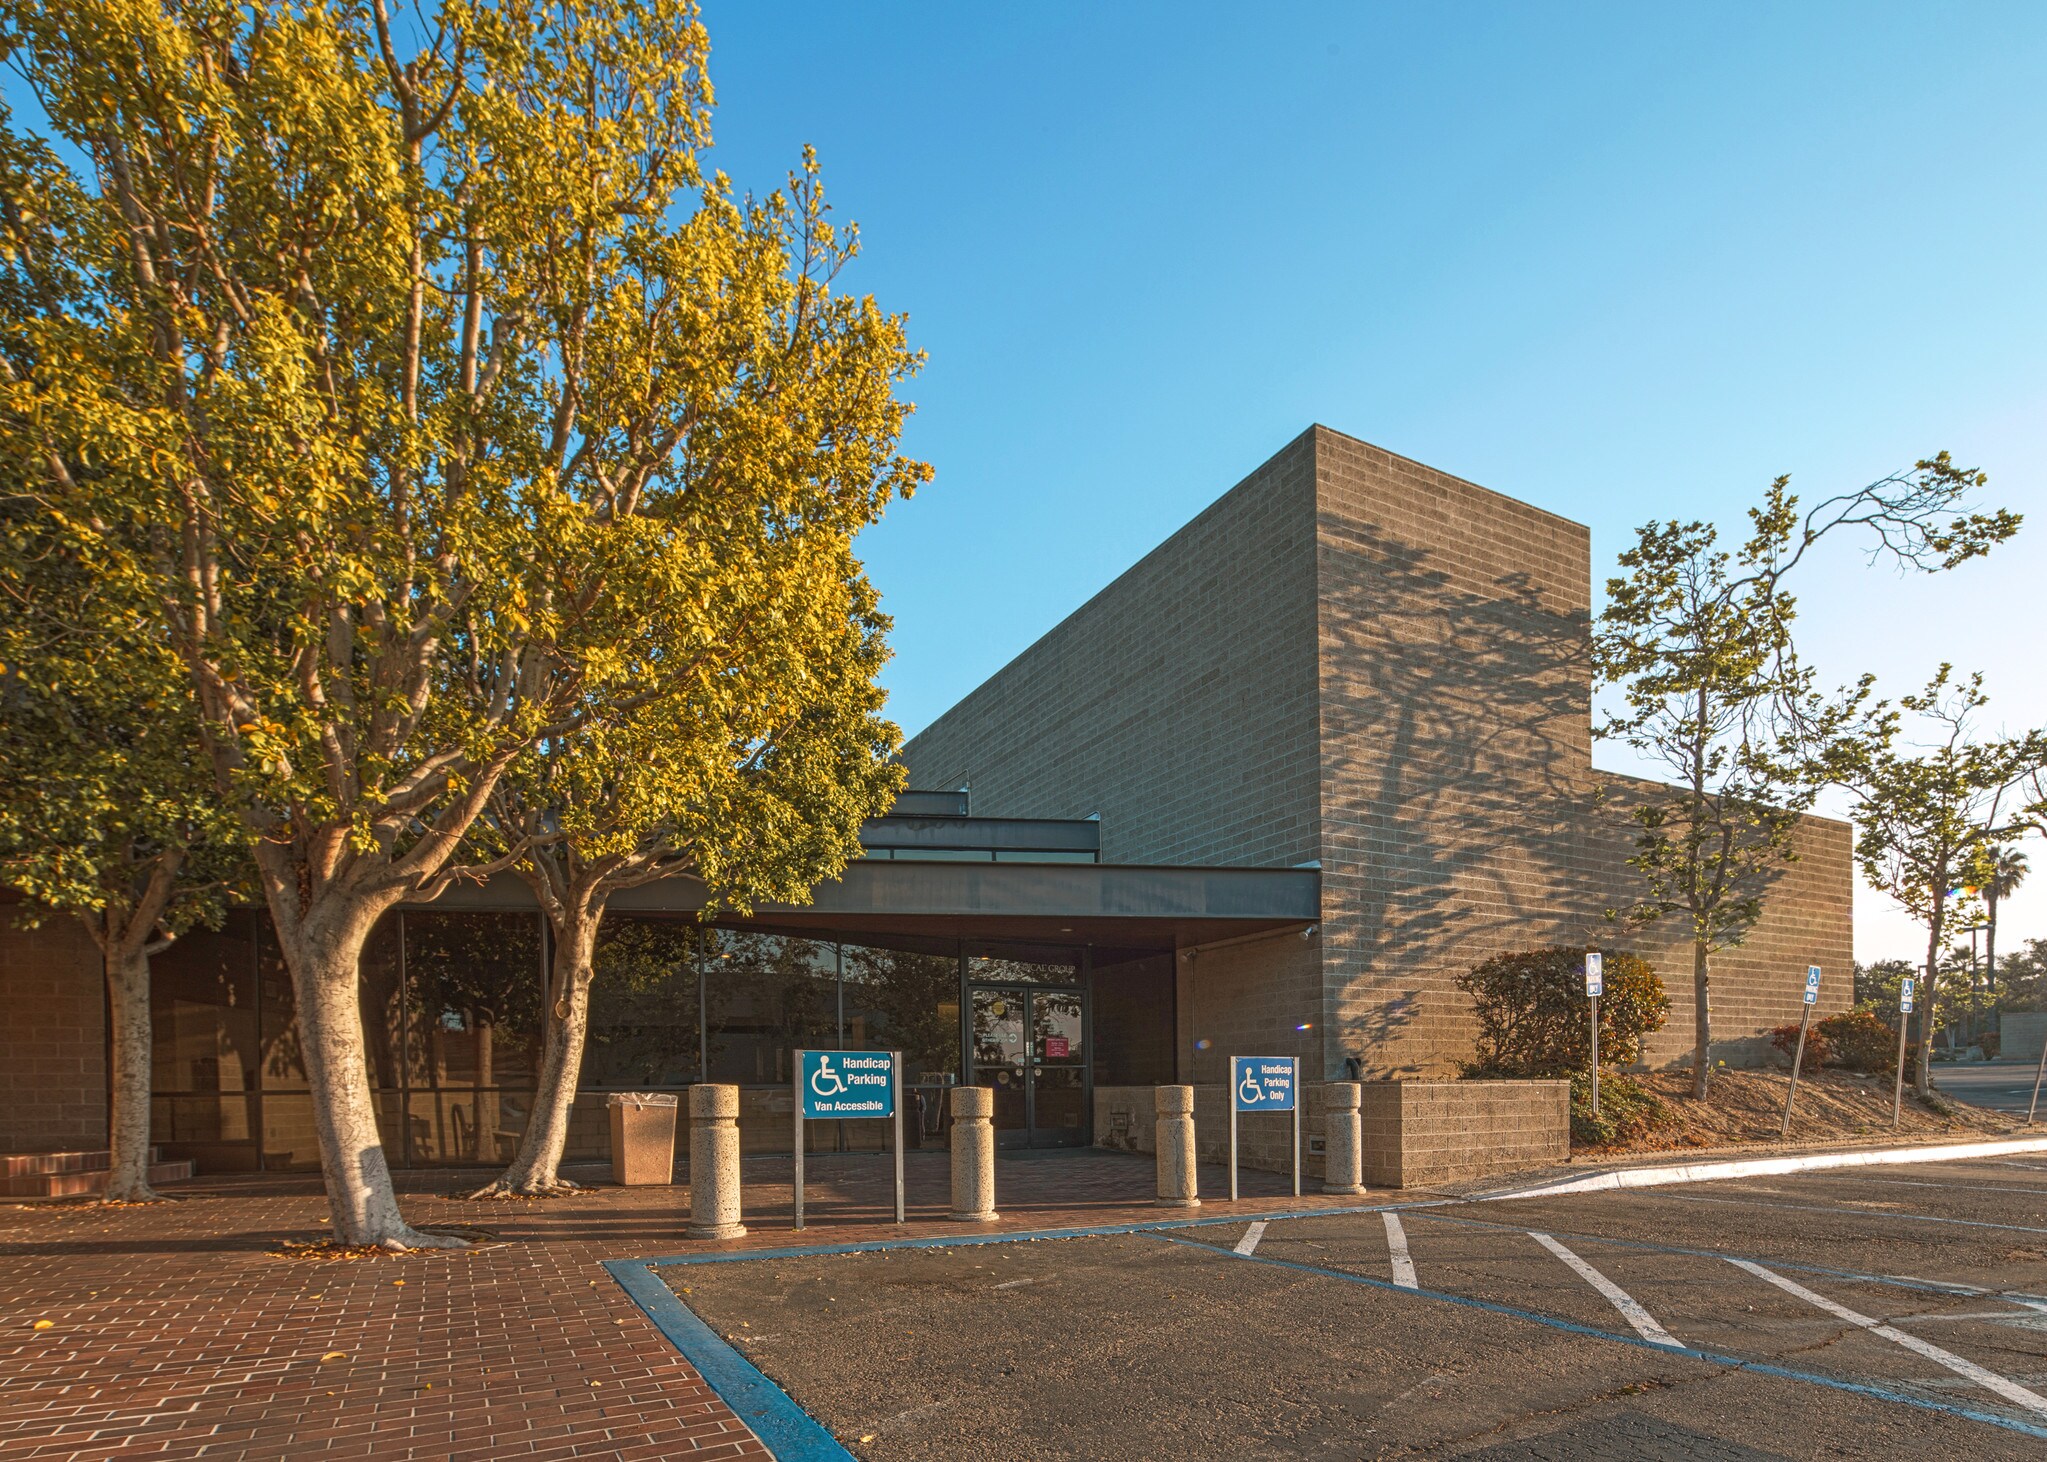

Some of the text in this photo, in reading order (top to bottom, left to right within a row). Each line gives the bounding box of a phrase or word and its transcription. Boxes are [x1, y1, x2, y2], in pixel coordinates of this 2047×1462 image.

[843, 1057, 890, 1070] Handicap
[1261, 1065, 1292, 1075] Handicap
[848, 1074, 886, 1086] Parking
[1264, 1078, 1289, 1088] Parking
[1270, 1091, 1284, 1101] Only
[814, 1101, 883, 1111] Van Accessible
